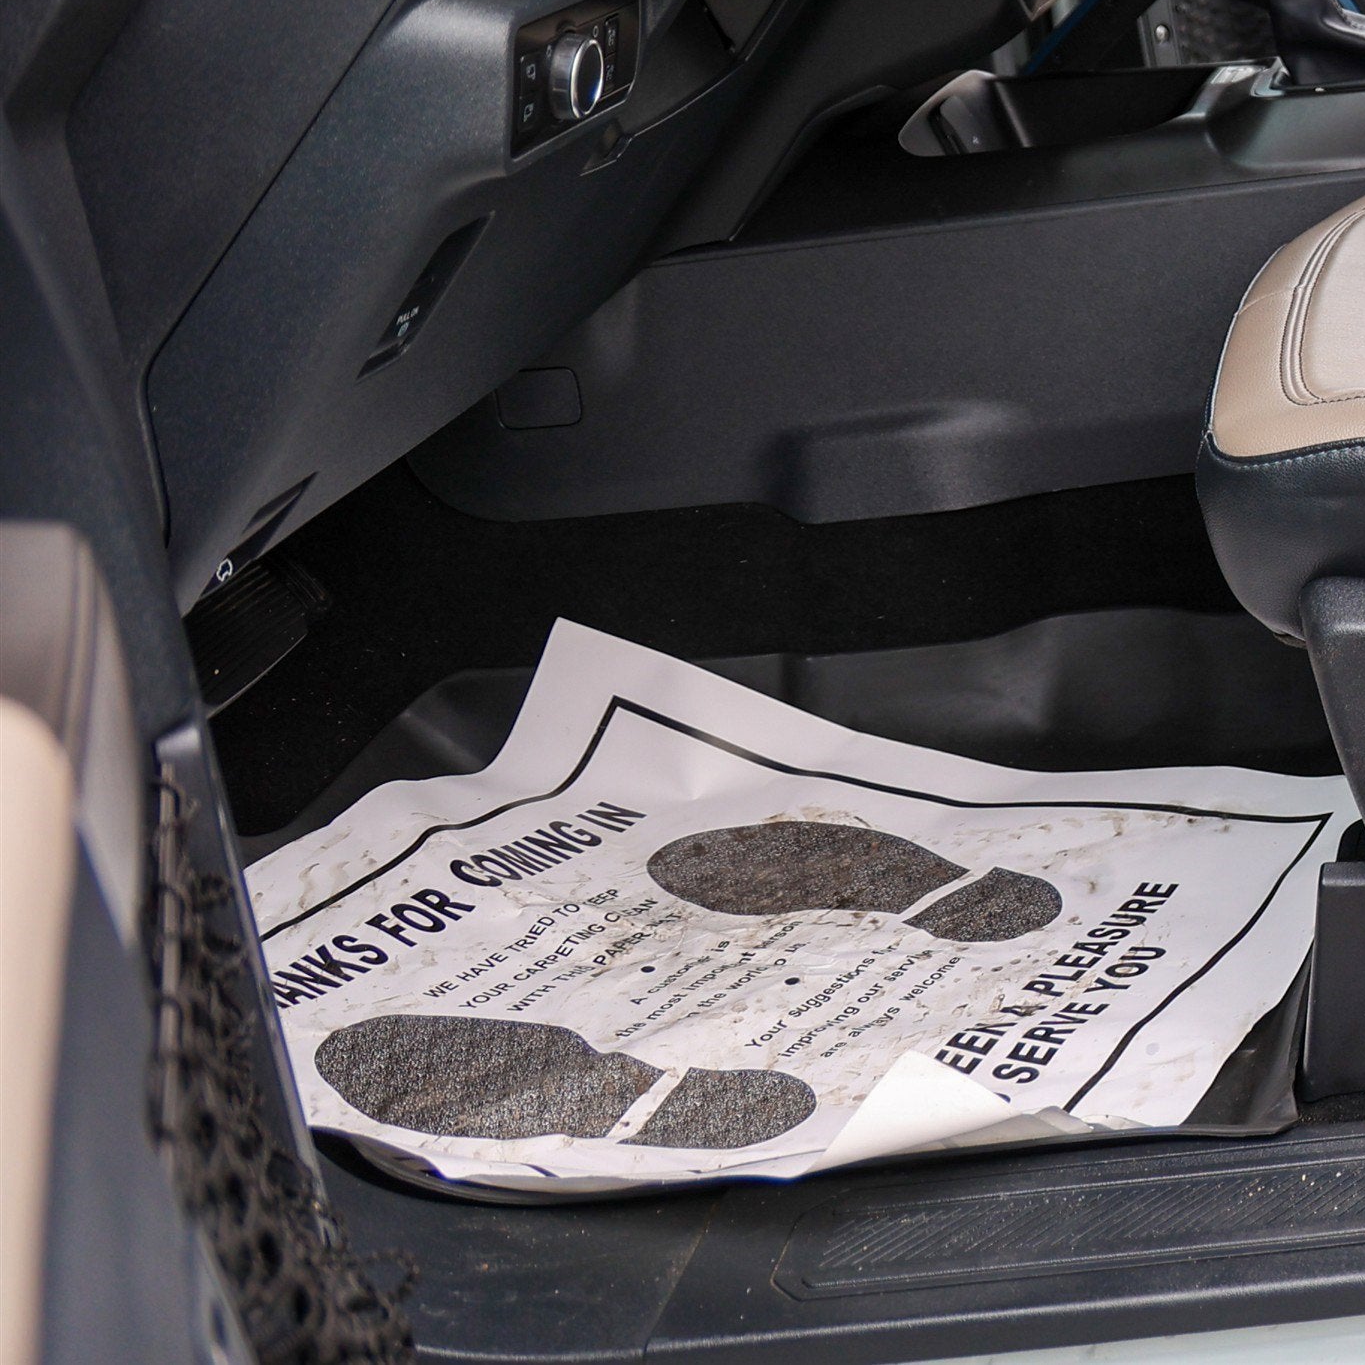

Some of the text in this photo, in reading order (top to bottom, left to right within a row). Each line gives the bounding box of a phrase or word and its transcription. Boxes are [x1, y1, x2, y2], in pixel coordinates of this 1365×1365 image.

[270, 801, 647, 1009] ANKS FOR COMING IN
[422, 980, 460, 1000] WE
[455, 951, 509, 982] HAVE
[504, 916, 556, 954] TRIED
[552, 902, 581, 918] TO
[458, 982, 517, 1010] YOUR
[513, 922, 607, 982] CARPETING
[506, 984, 557, 1013] WITH
[551, 963, 595, 983] THIS
[592, 931, 652, 966] PAPER
[630, 996, 649, 1006] A
[711, 940, 731, 953] is
[934, 881, 1180, 1075] EEN A PLEASURE
[615, 1021, 648, 1038] the
[646, 993, 689, 1021] most
[696, 991, 728, 1009] the
[744, 1020, 789, 1049] Your
[788, 956, 876, 1018] suggestions
[777, 1005, 861, 1059] improving
[857, 982, 884, 1004] our
[819, 1041, 848, 1059] are
[848, 1005, 901, 1038] always
[991, 946, 1167, 1084] SERVE YOU
